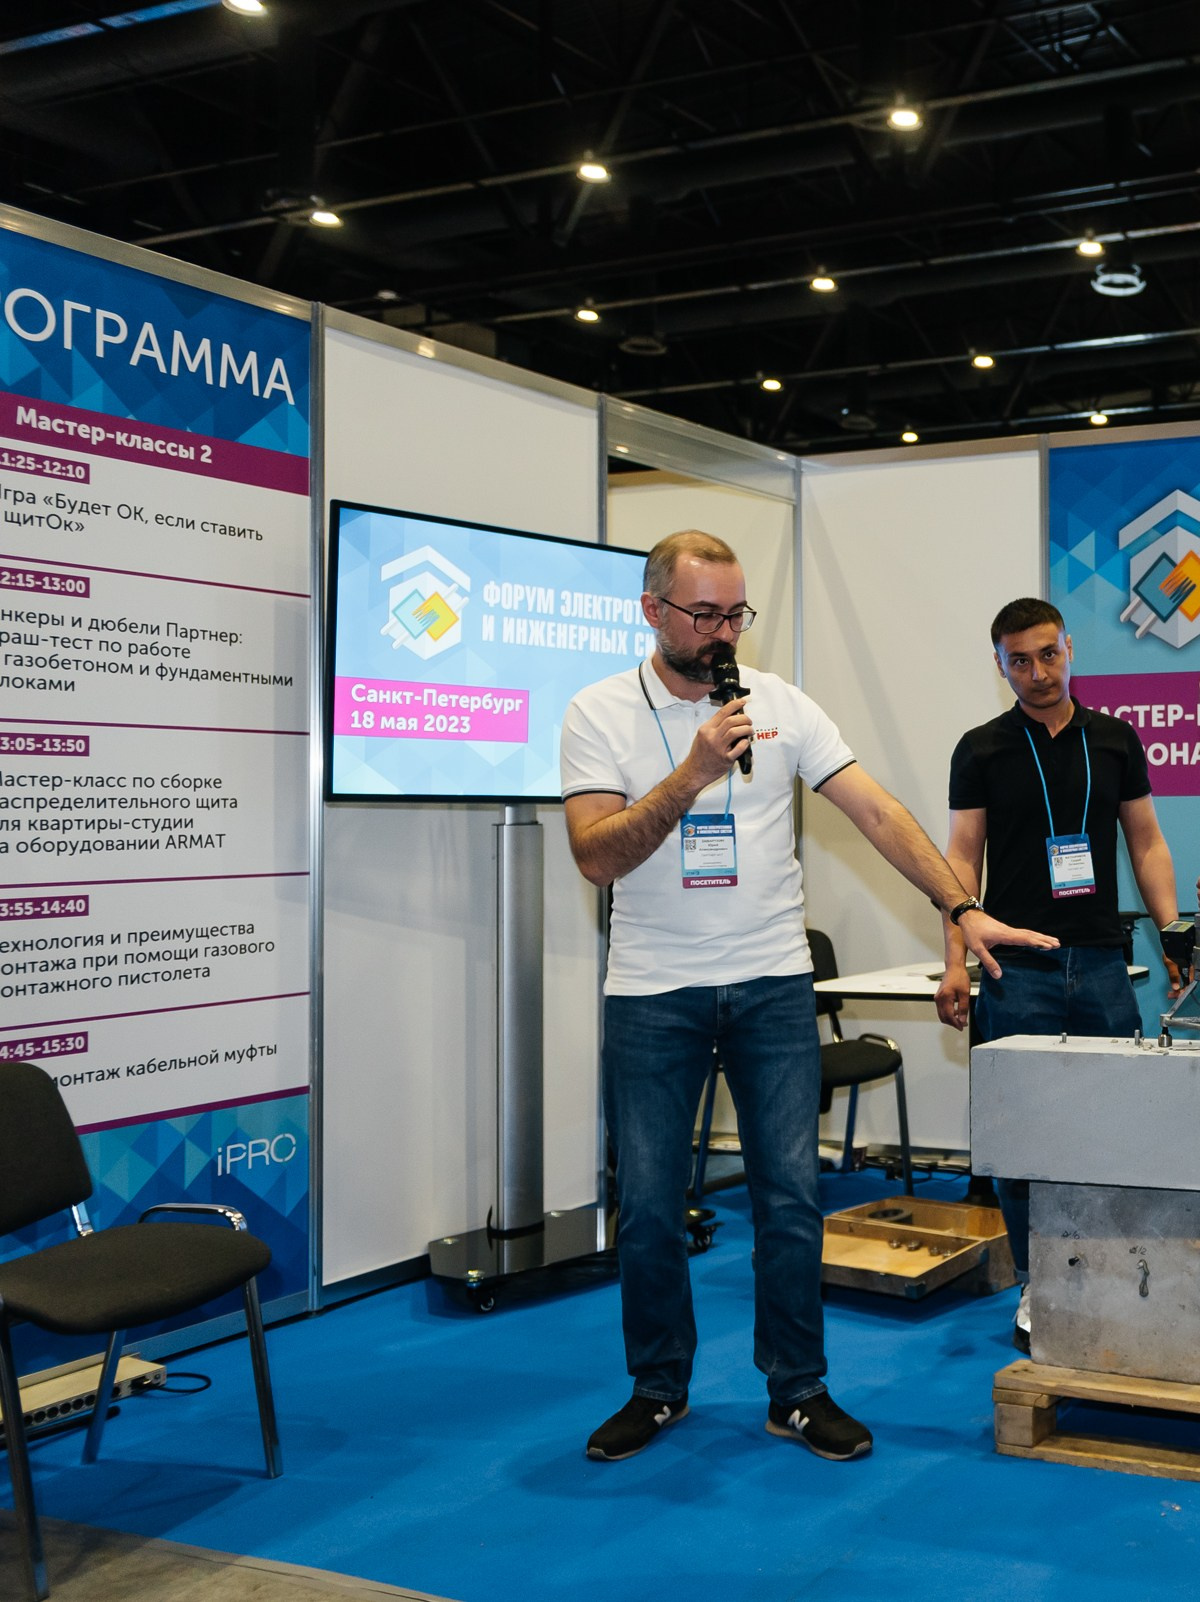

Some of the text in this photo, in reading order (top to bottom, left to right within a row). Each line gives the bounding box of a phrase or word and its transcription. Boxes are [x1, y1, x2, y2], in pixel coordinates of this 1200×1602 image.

[0, 287, 295, 406] ОГРАММА
[16, 405, 213, 464] Мастер-классы 2
[0, 452, 86, 479] 1:25-12:10
[0, 484, 264, 541] гра «Будет ОК, если ставить
[4, 511, 85, 532] щитОк»
[482, 580, 555, 616] ФОРУМ
[1, 609, 244, 646] нкеры и дюбели Партнер:
[482, 614, 495, 643] И
[502, 616, 628, 656] ИНЖЕНЕРНЫХ
[0, 631, 192, 659] раш-тест по работе
[0, 675, 76, 692] локами
[4, 653, 293, 687] газобетоном и фундаментными
[351, 683, 523, 715] Санкт-Петербург
[350, 710, 471, 733] 18 мая 2023
[0, 770, 223, 792] астер-класс по сборке
[0, 796, 239, 813] аспределительного щита
[28, 817, 194, 835] квартиры-студии
[16, 836, 160, 857] оборудовании
[165, 833, 226, 850] ARMAT
[0, 923, 255, 954] ехнология и преимущества
[1, 941, 275, 976] онтажа при помощи газового
[0, 966, 211, 998] онтажного пистолета
[126, 1049, 219, 1077] кабельной
[224, 1043, 278, 1064] муфты
[217, 1133, 296, 1177] iPRO
